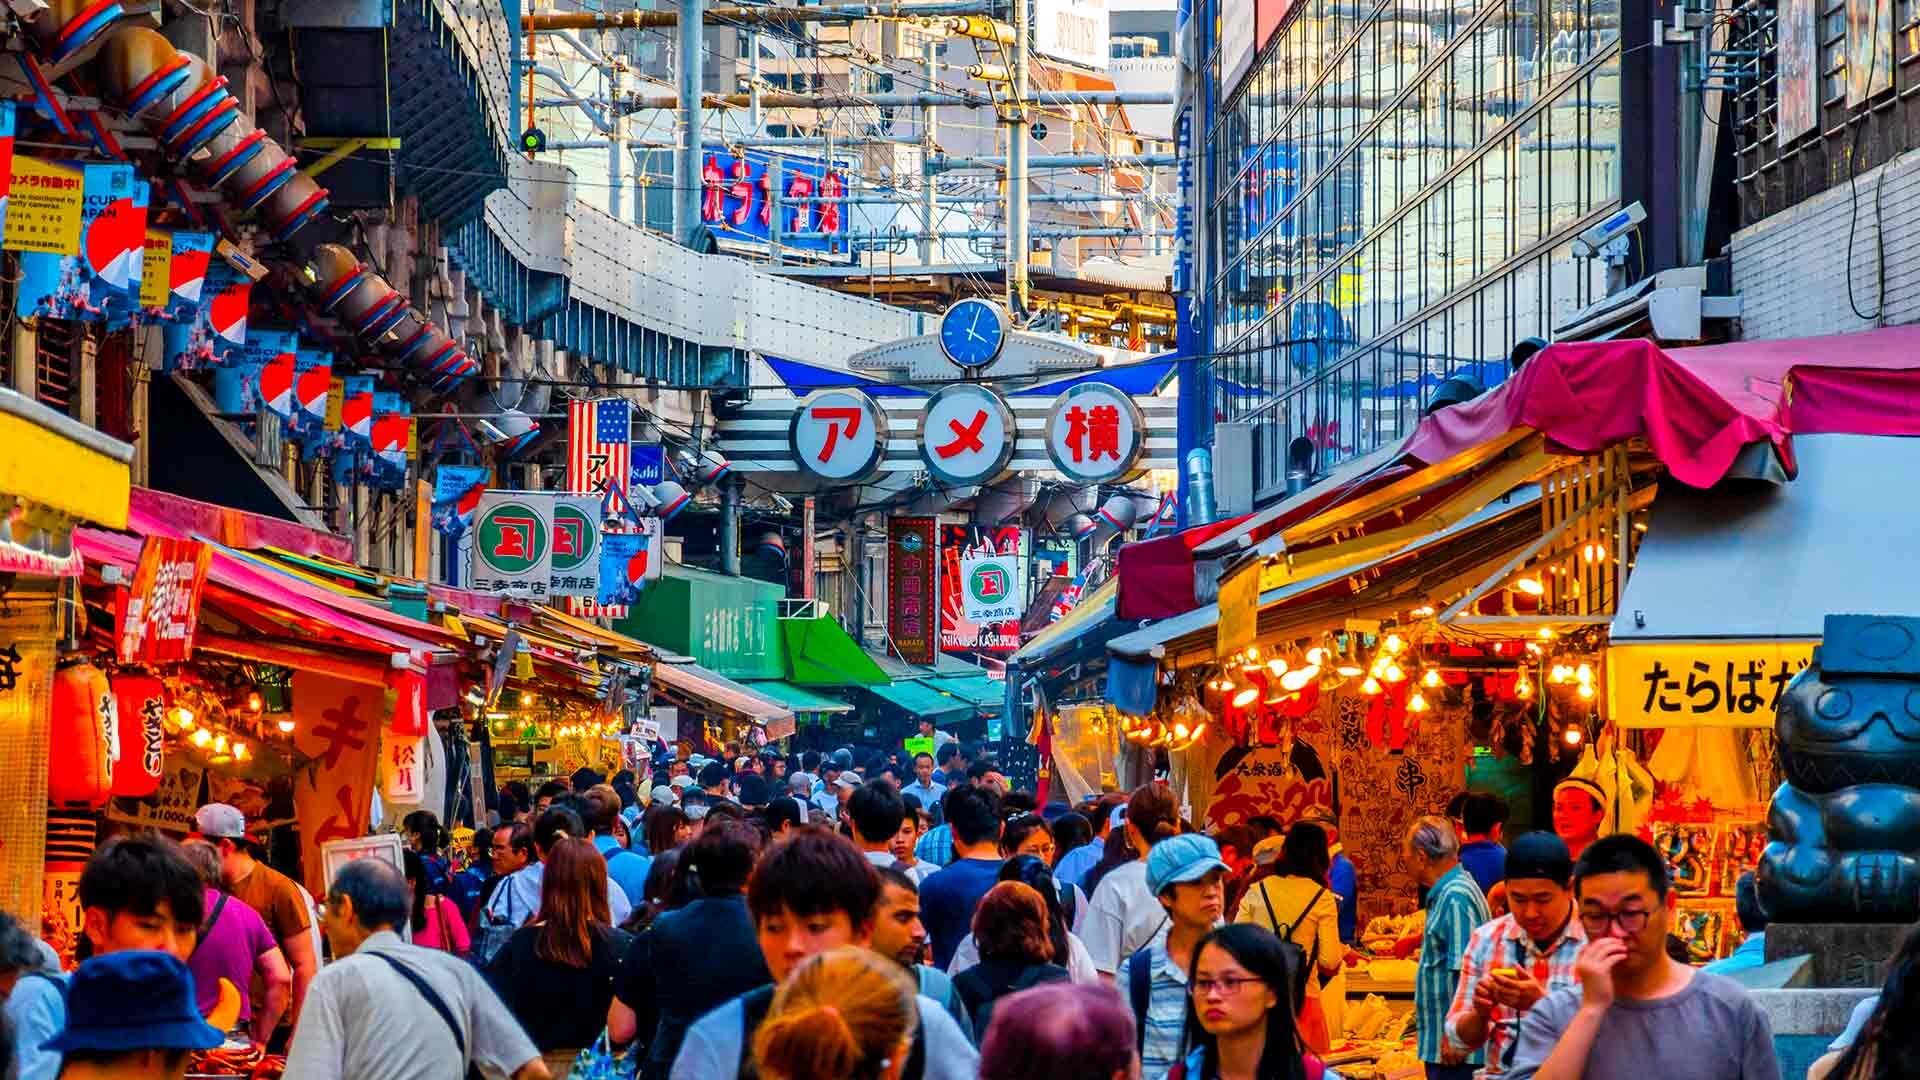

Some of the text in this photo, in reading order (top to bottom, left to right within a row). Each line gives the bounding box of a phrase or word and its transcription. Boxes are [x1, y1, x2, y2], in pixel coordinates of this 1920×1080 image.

[89, 194, 117, 206] CUP
[81, 207, 117, 218] APAN
[811, 405, 1120, 464] アメ横
